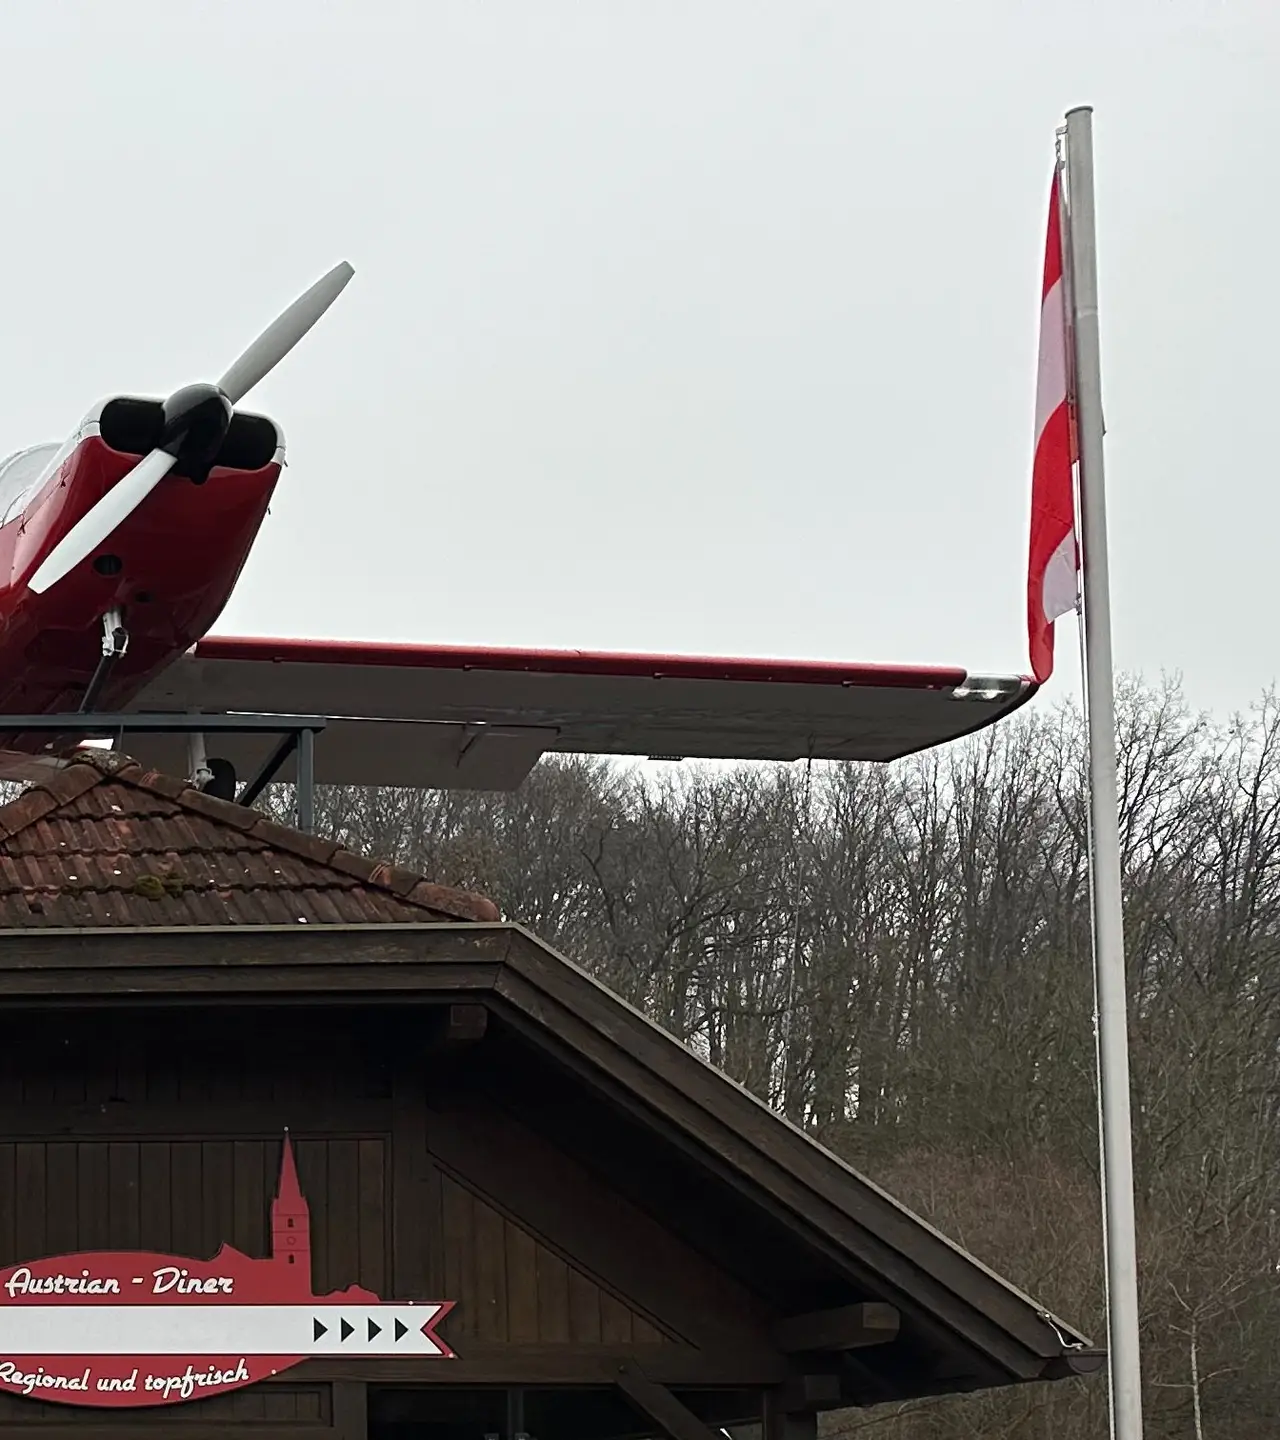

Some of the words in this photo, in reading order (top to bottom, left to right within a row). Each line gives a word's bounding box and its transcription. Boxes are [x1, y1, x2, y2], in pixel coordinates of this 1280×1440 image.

[4, 1266, 120, 1298] Austrian
[152, 1266, 234, 1294] Diner
[96, 1368, 139, 1392] und
[144, 1357, 250, 1399] topfrisch
